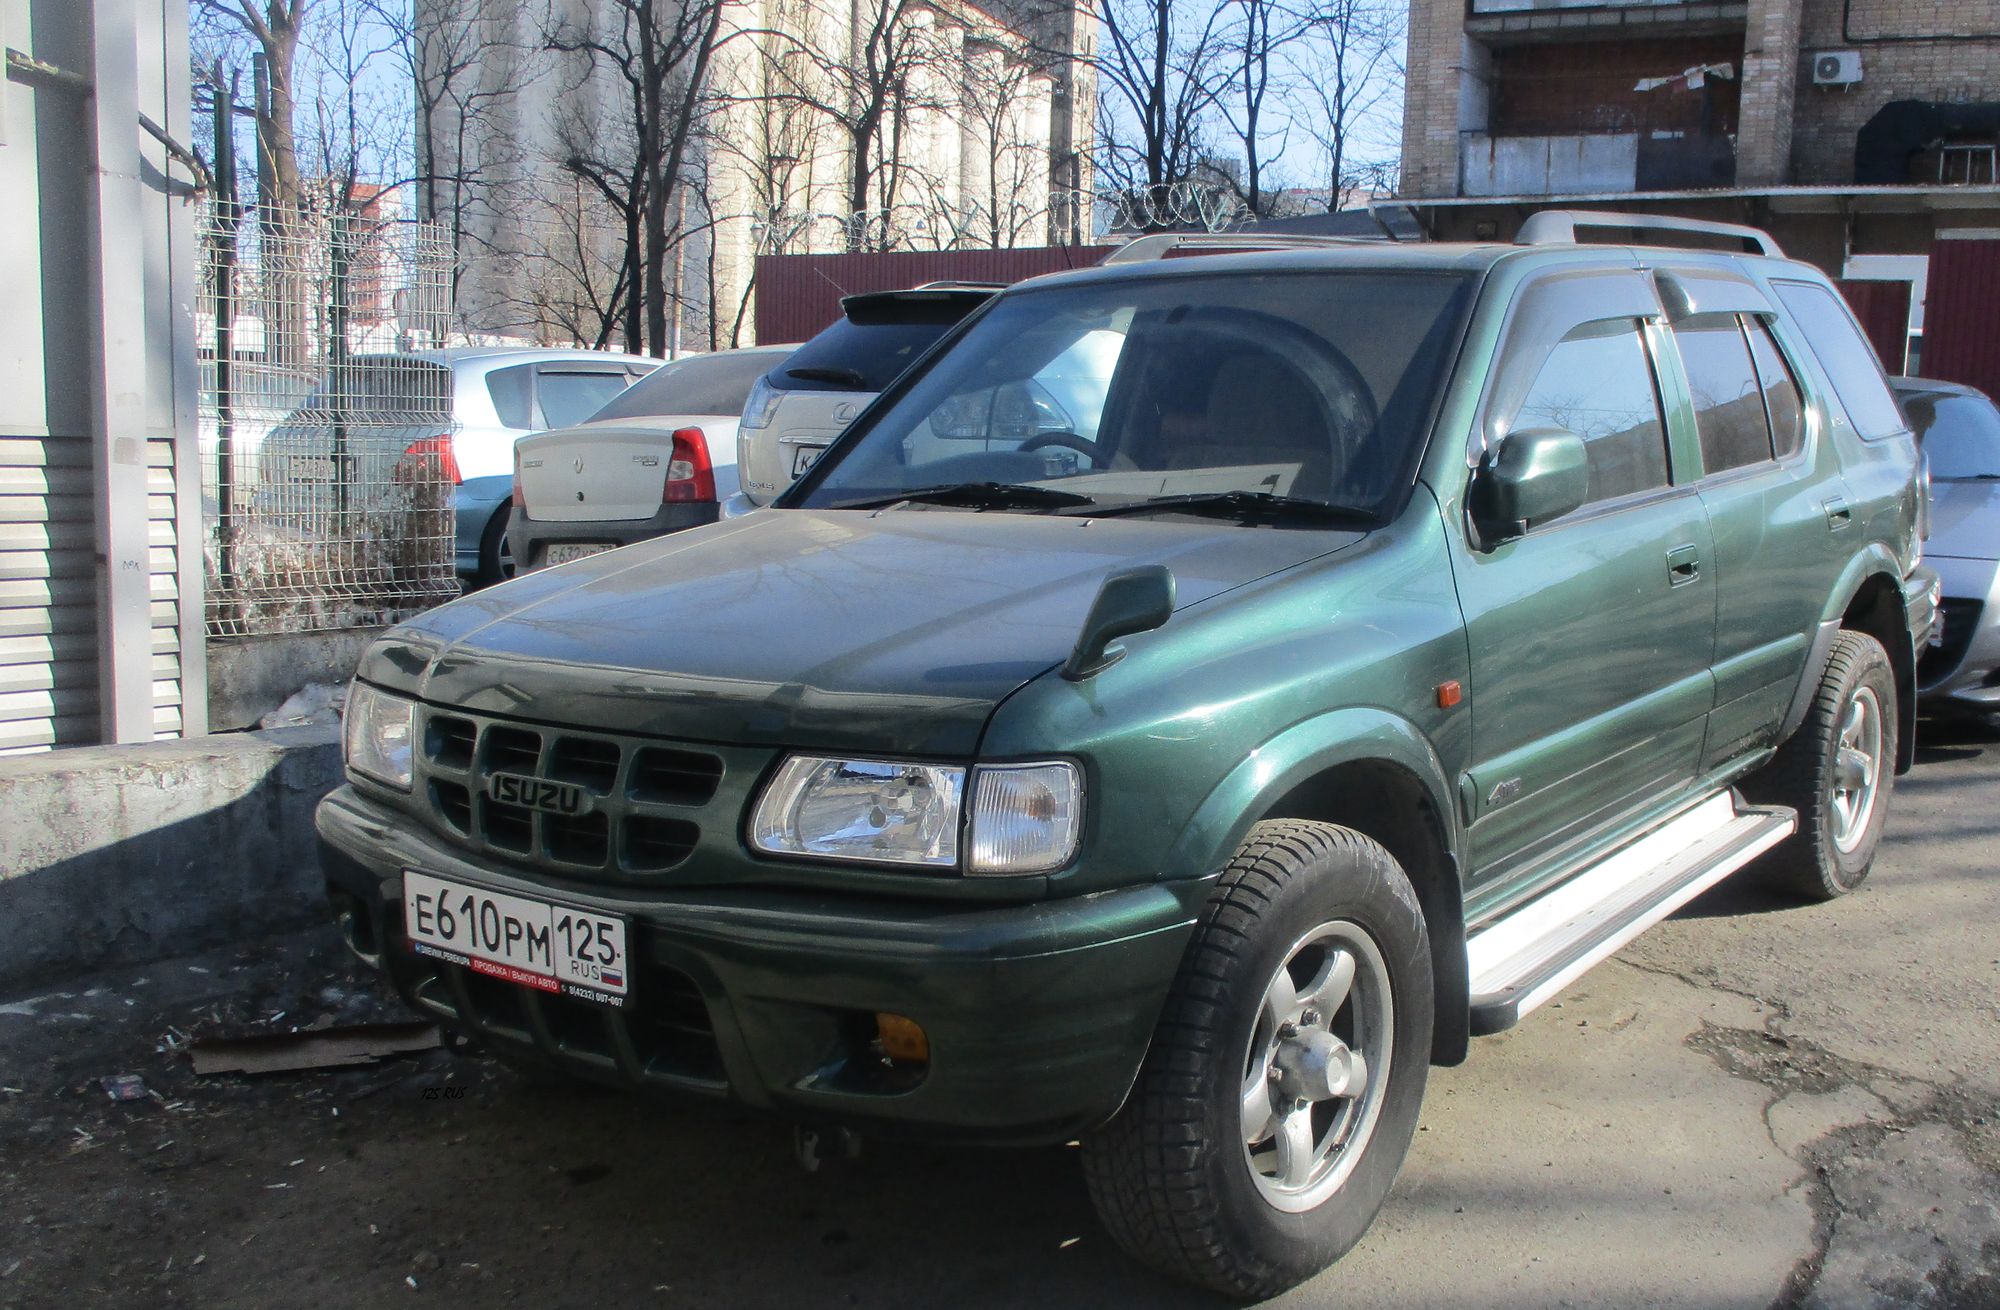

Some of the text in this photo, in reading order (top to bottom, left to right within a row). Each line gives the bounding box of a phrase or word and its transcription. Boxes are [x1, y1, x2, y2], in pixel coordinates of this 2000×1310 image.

[493, 774, 580, 813] ISUZU
[557, 915, 615, 966] 125
[473, 959, 508, 976] ПРОДАЖА
[511, 970, 538, 985] ВЫКУП
[537, 977, 558, 991] АВТО
[571, 960, 600, 980] RUS
